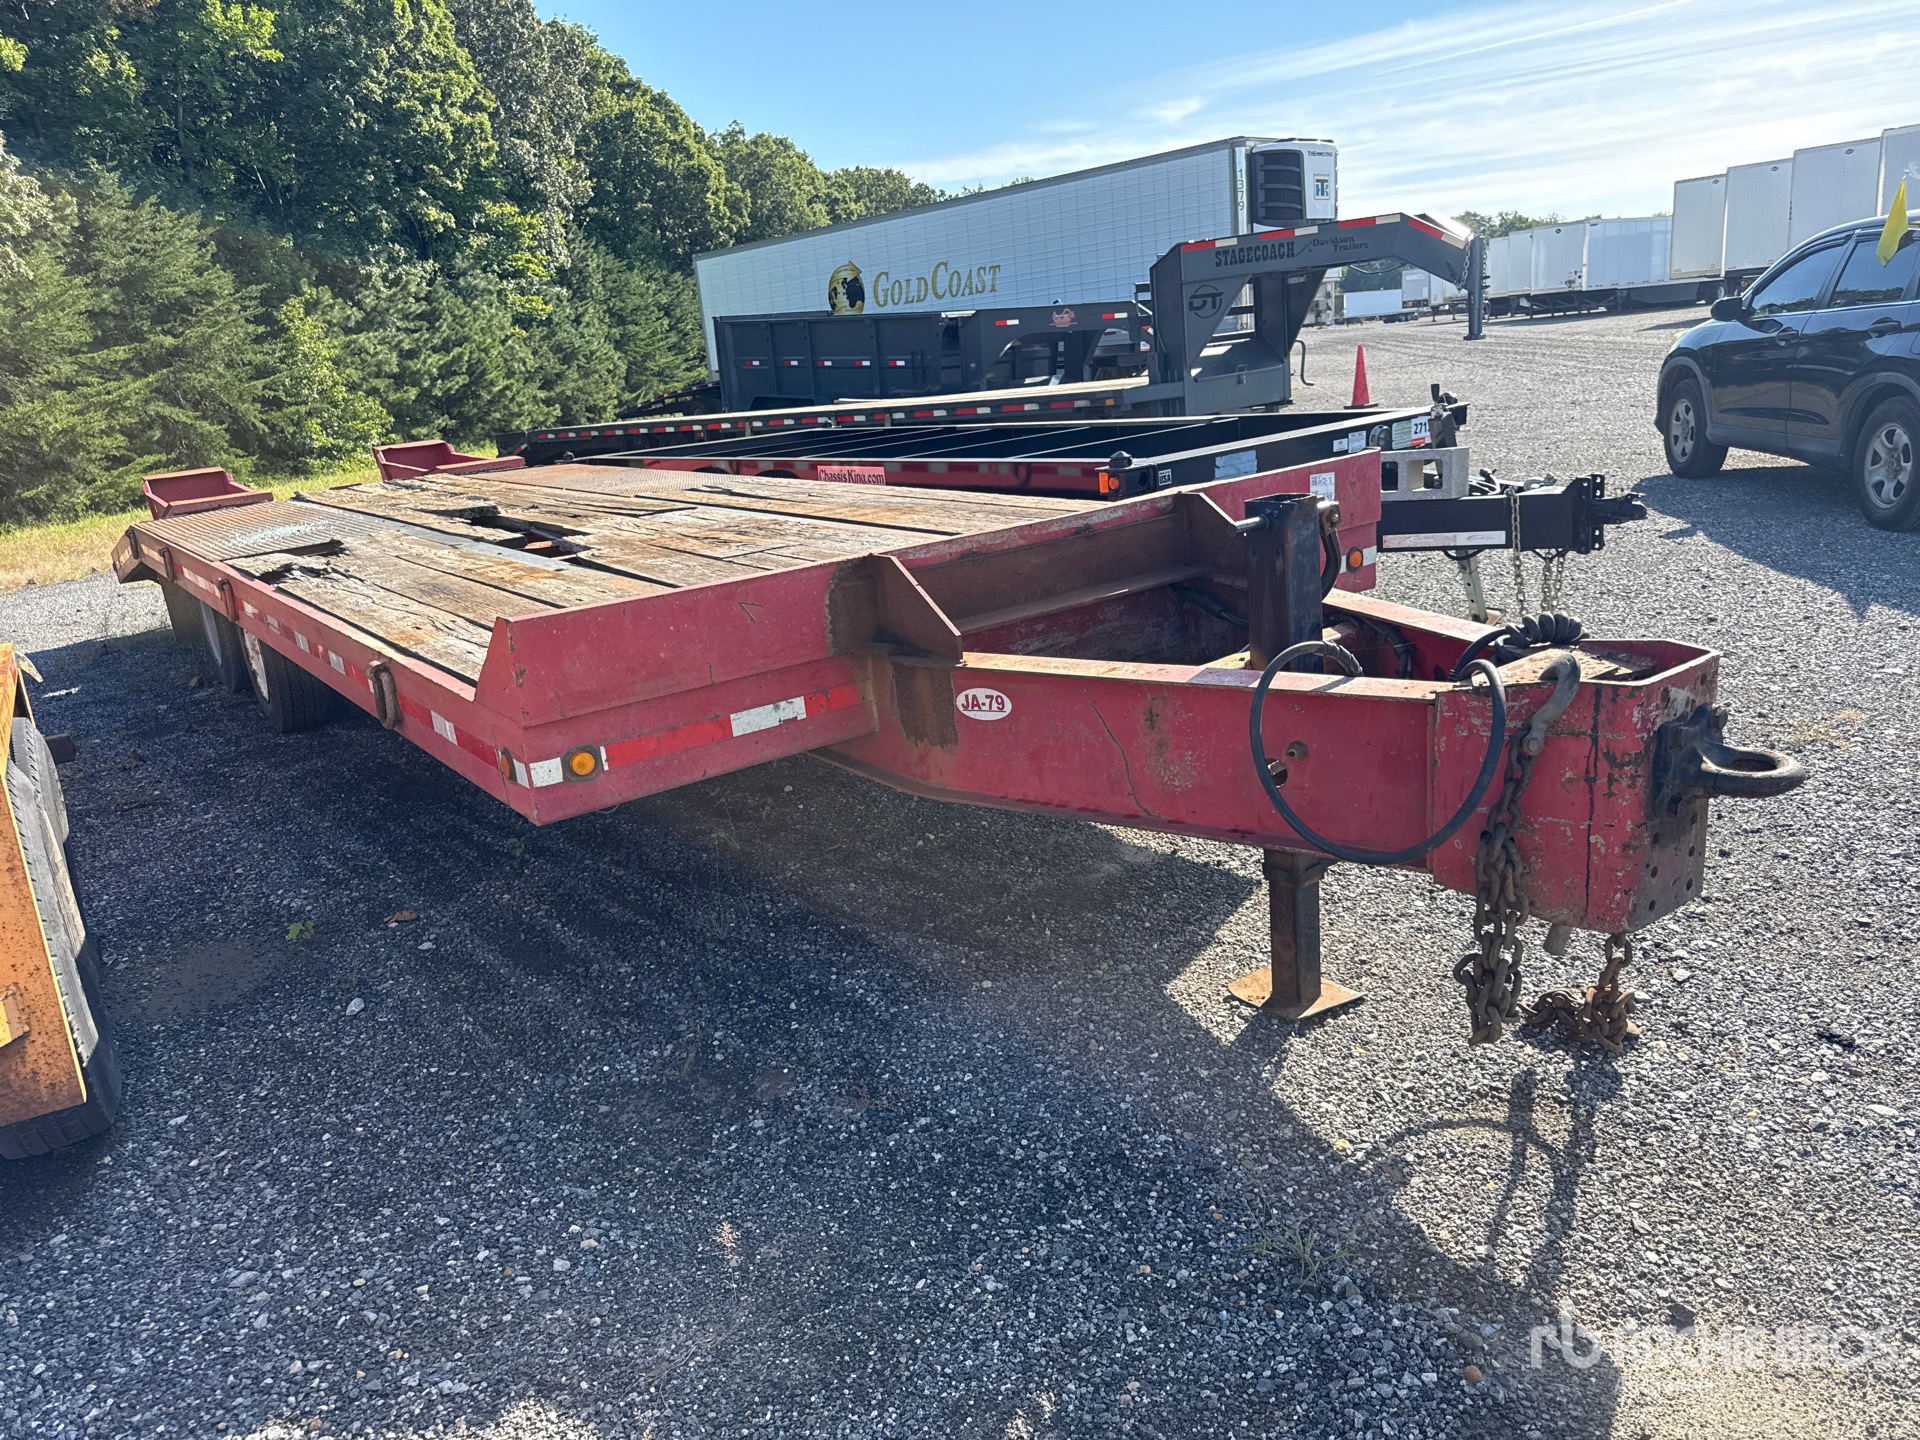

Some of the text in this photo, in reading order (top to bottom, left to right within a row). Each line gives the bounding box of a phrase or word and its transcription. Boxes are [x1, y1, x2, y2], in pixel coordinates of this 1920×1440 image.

[1237, 168, 1245, 211] 1379
[1312, 236, 1355, 247] Davidson
[1332, 242, 1369, 252] Trailers
[1214, 241, 1296, 267] STAGECOACH
[1413, 421, 1430, 435] 271
[818, 468, 885, 485] ChassisKing.com
[1159, 473, 1171, 484] USA
[961, 694, 1005, 711] JA-79
